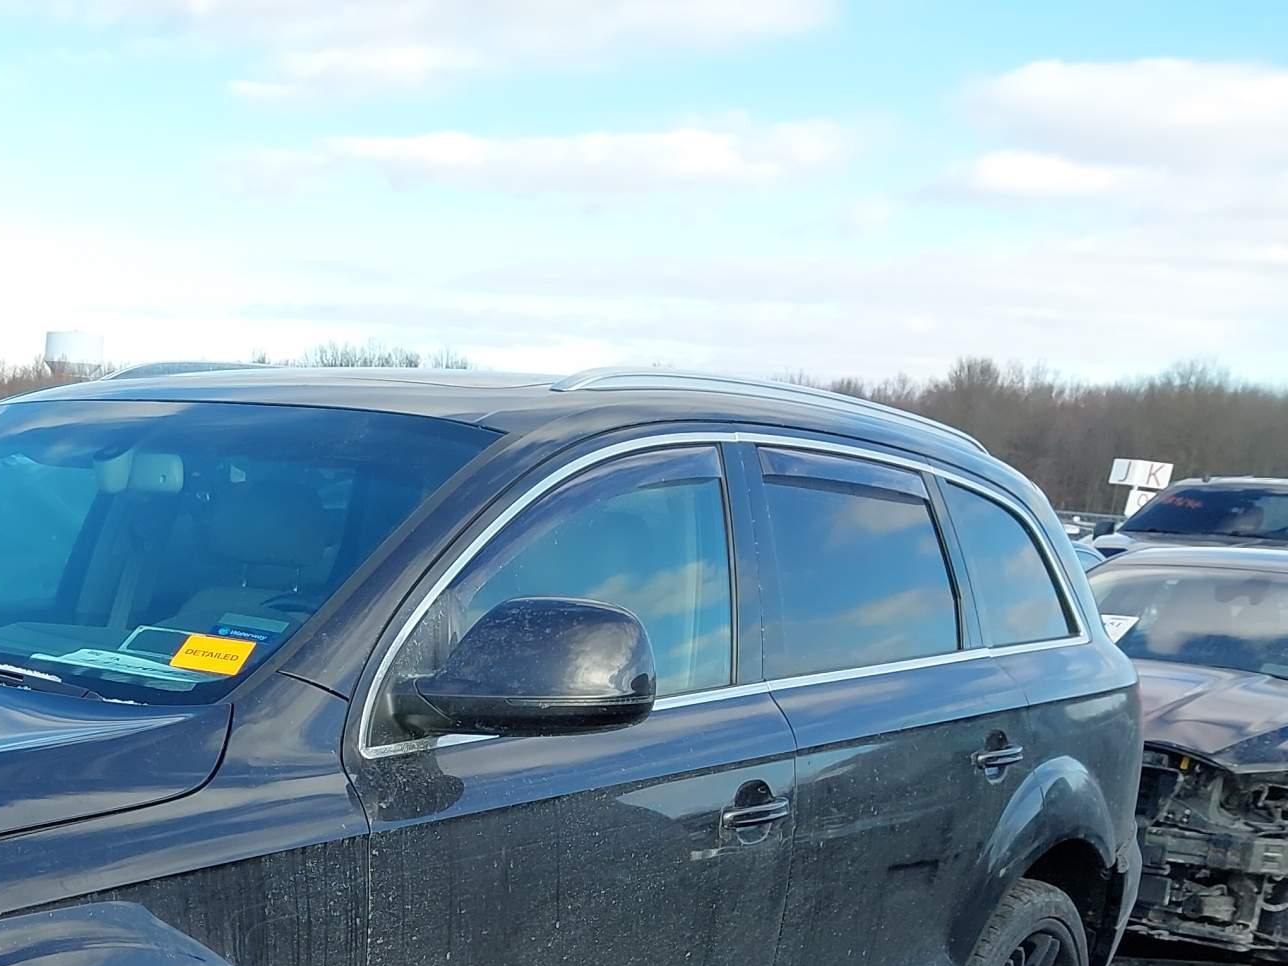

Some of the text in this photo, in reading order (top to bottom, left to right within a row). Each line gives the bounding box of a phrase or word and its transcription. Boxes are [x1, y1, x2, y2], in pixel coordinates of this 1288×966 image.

[1117, 460, 1165, 487] J K
[184, 648, 239, 662] DETAILED
